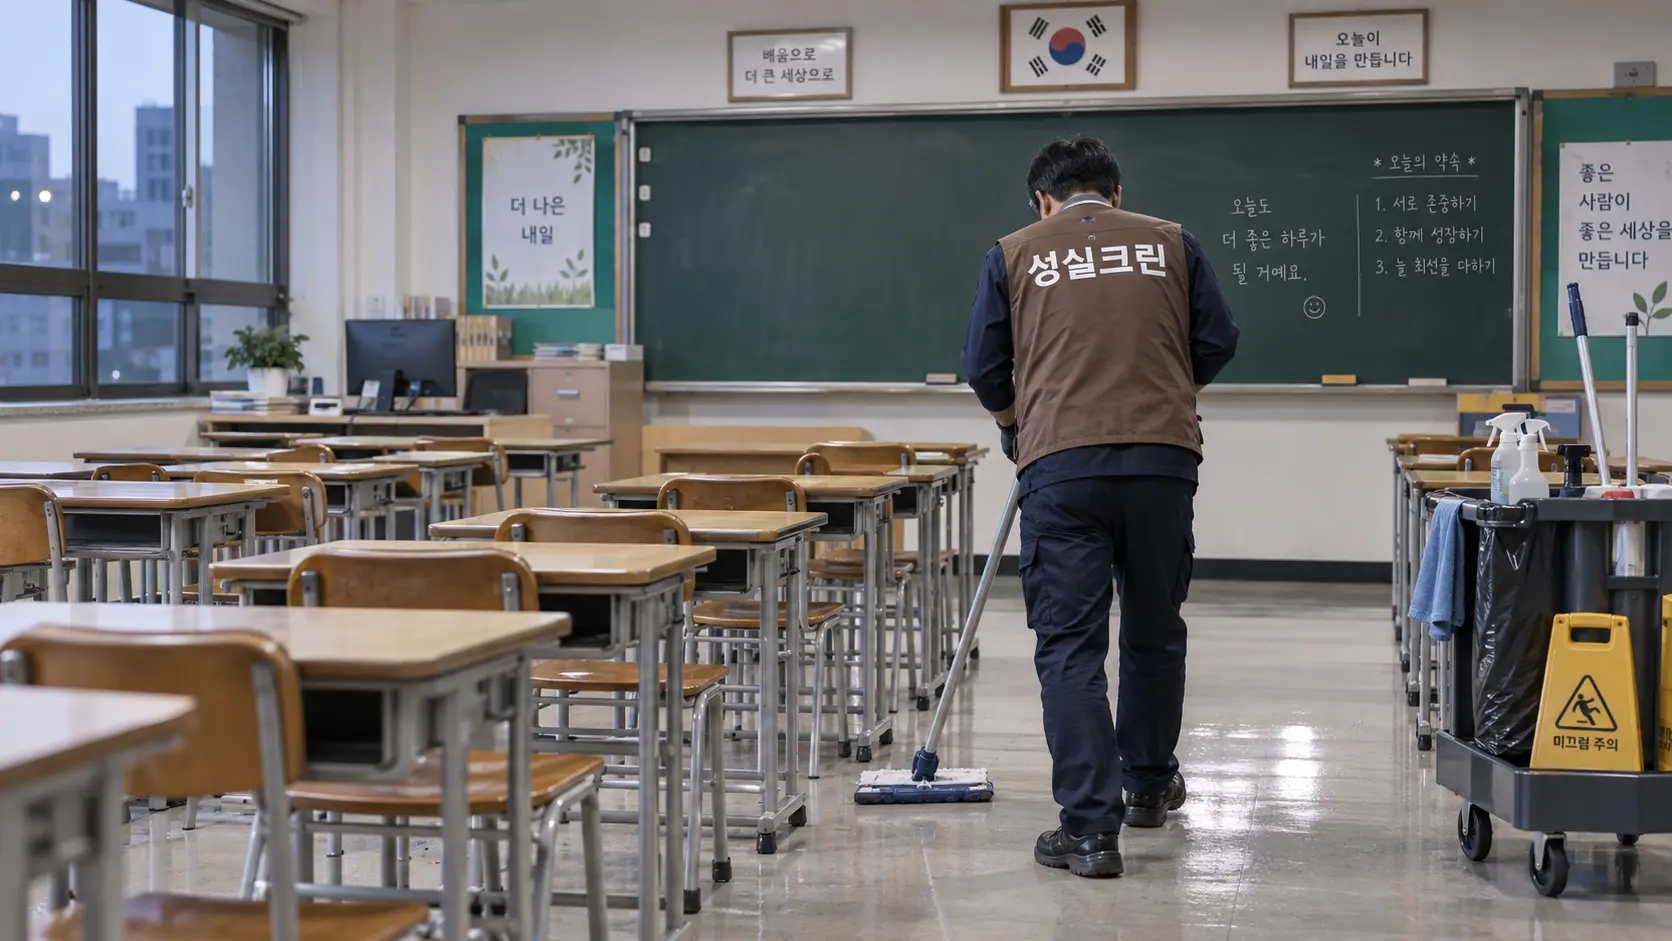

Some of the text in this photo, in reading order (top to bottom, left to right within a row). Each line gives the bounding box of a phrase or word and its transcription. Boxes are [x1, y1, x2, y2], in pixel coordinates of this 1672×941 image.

[1336, 30, 1380, 47] 오늘이
[762, 47, 816, 63] 배움으로
[1305, 51, 1412, 70] 내일을 만듭니다
[745, 67, 835, 84] 더 큰 세상으로
[1389, 152, 1460, 173] 오늘의 약속
[1579, 163, 1614, 183] 좋은
[510, 196, 565, 216] 더 나은
[1229, 196, 1272, 218] 오늘도
[1375, 194, 1476, 214] 1. 서로 존중하기
[1579, 192, 1630, 211] 사람이
[521, 225, 554, 245] 내일
[1222, 228, 1325, 252] 더 좋은 하루가
[1375, 226, 1484, 245] 2. 함께 성장하기
[1578, 220, 1672, 241] 좋은 세상을
[1027, 243, 1167, 287] 성실크린
[1375, 256, 1495, 277] 3. 늘 최선을 다하기
[1578, 250, 1649, 270] 만듭니다
[1232, 262, 1307, 285] 될 거예요.
[1553, 735, 1618, 752] 미끄럼 주의
